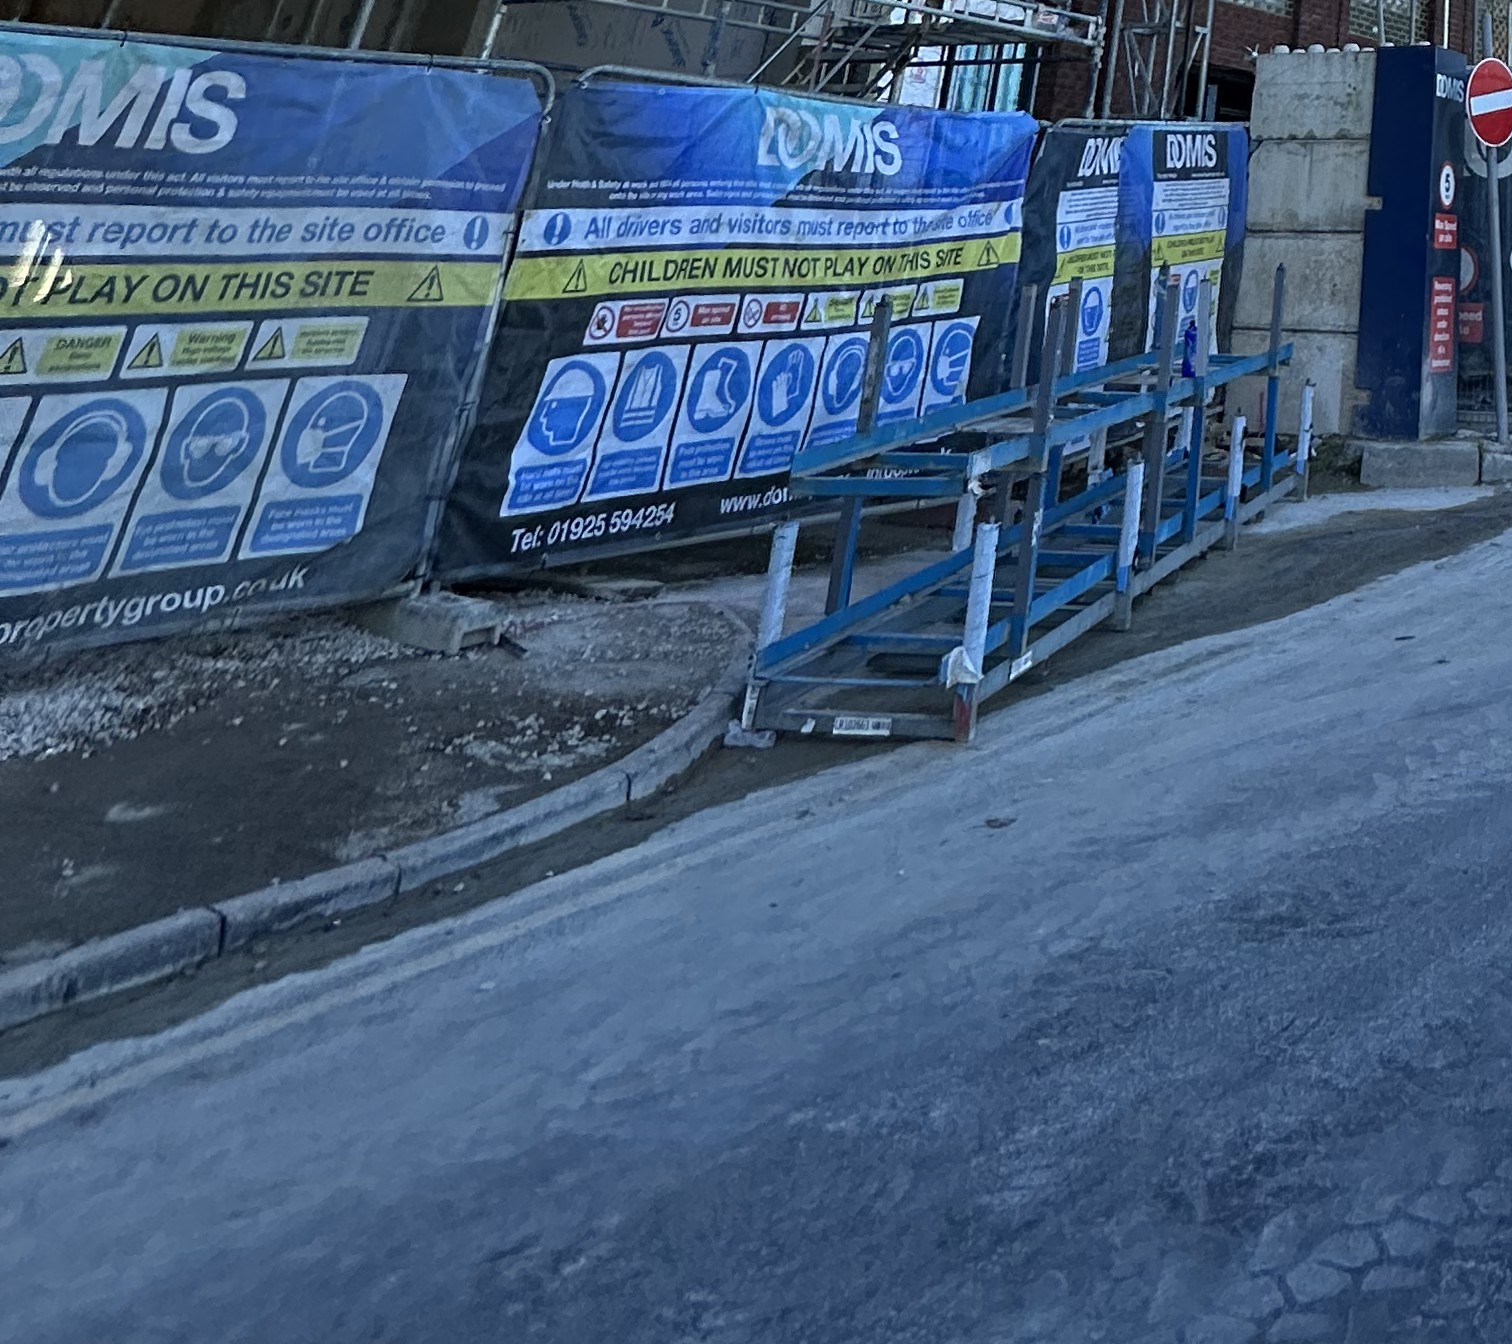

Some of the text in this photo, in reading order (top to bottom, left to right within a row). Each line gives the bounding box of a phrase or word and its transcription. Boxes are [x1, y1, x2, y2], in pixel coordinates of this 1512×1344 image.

[1436, 73, 1465, 103] DOMIS
[757, 105, 903, 176] DOMIS
[1166, 133, 1218, 170] DOMIS
[1445, 173, 1451, 193] 5
[86, 216, 198, 249] report
[205, 219, 238, 244] to
[252, 215, 296, 246] the
[300, 215, 356, 245] site
[363, 216, 446, 246] office
[584, 216, 612, 240] All
[616, 214, 683, 238] drivers
[688, 212, 722, 235] and
[728, 212, 792, 236] visitors
[797, 218, 837, 237] must
[837, 218, 892, 240] report
[893, 218, 908, 236] to
[957, 210, 993, 229] office
[608, 246, 965, 285] CHILDREN MUST NOT PLAY ON THIS SITE
[41, 273, 151, 306] PLAY
[152, 273, 210, 305] ON
[217, 271, 294, 302] THIS
[301, 269, 374, 299] SITE
[56, 336, 113, 350] DANGER
[188, 331, 237, 345] Warning
[510, 501, 676, 553] Tel: 01925 594254
